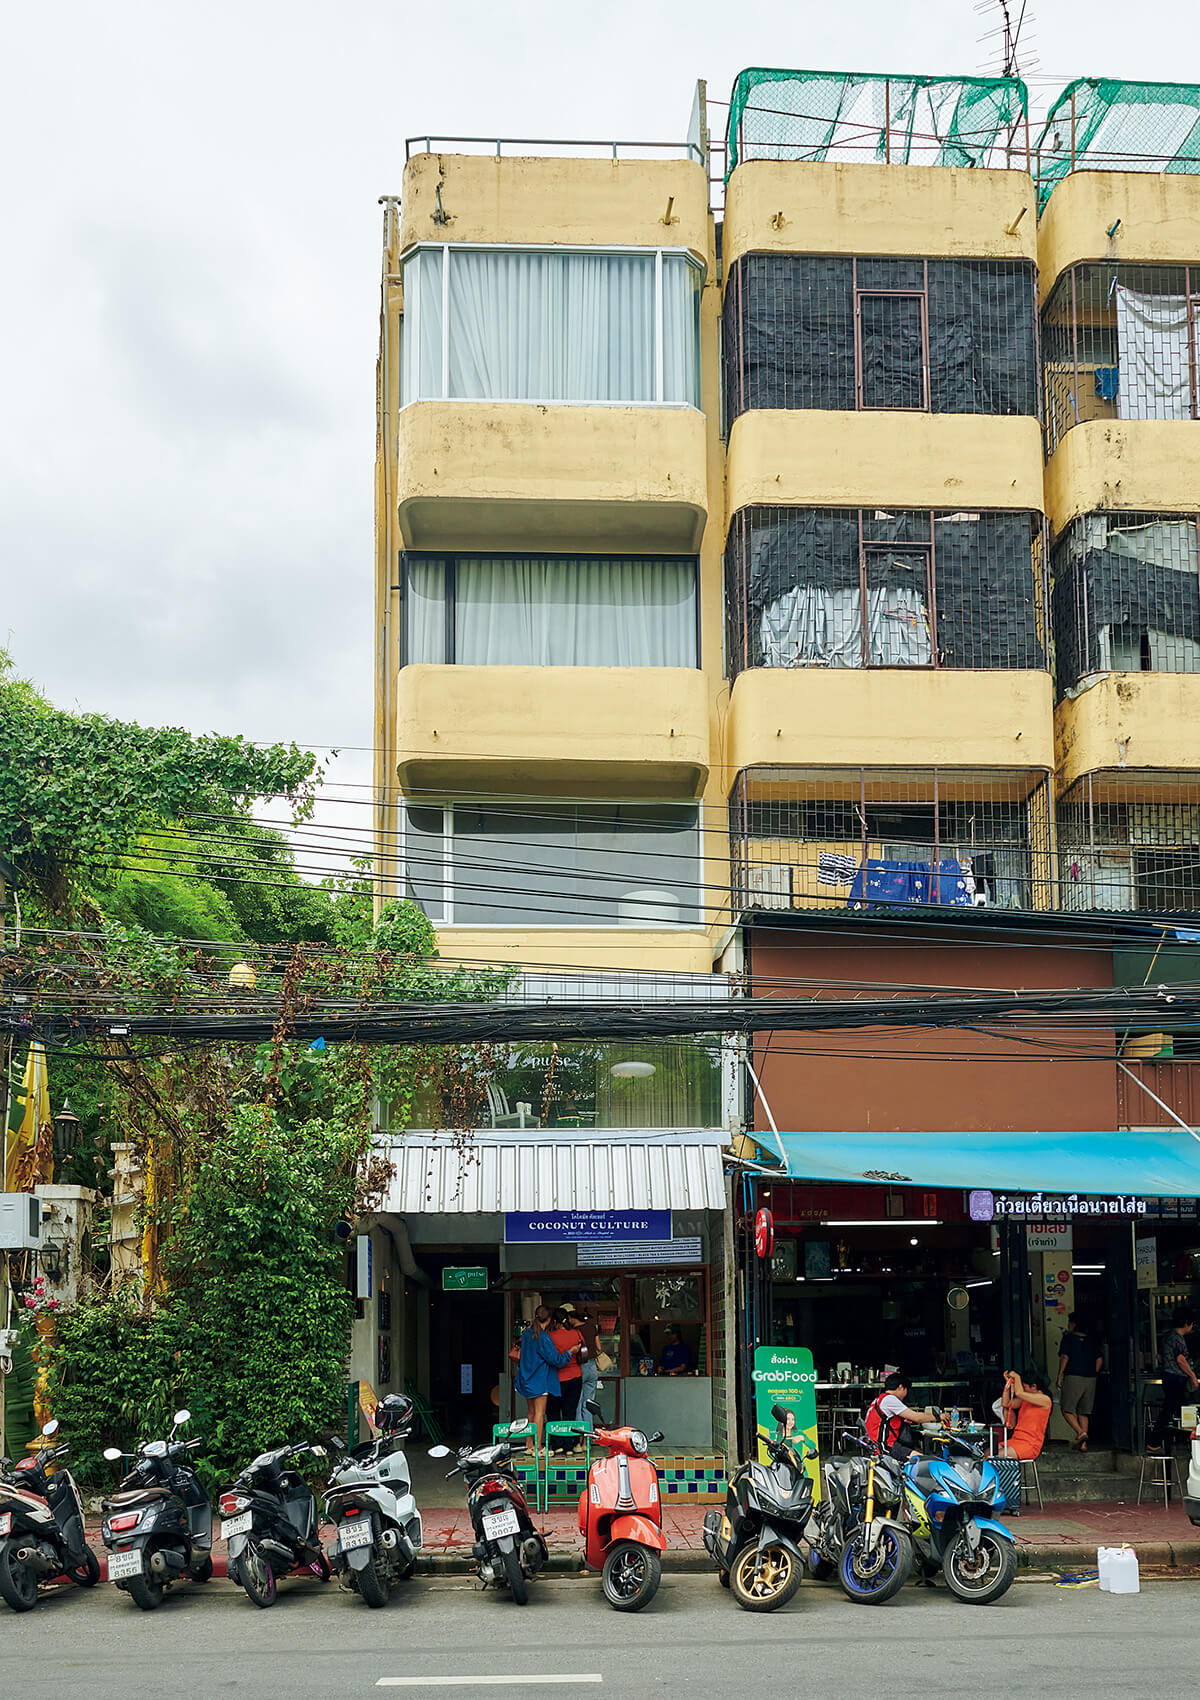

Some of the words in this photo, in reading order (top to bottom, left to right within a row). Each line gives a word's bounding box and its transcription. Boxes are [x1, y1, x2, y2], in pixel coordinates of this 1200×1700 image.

[528, 1221, 586, 1230] COCONUT
[591, 1221, 649, 1230] CULTURE
[770, 1353, 798, 1364] สั่งผ่าน
[752, 1370, 817, 1382] GrabFood
[491, 1526, 514, 1538] 9007
[345, 1537, 368, 1548] 8313
[114, 1566, 137, 1578] 8356
